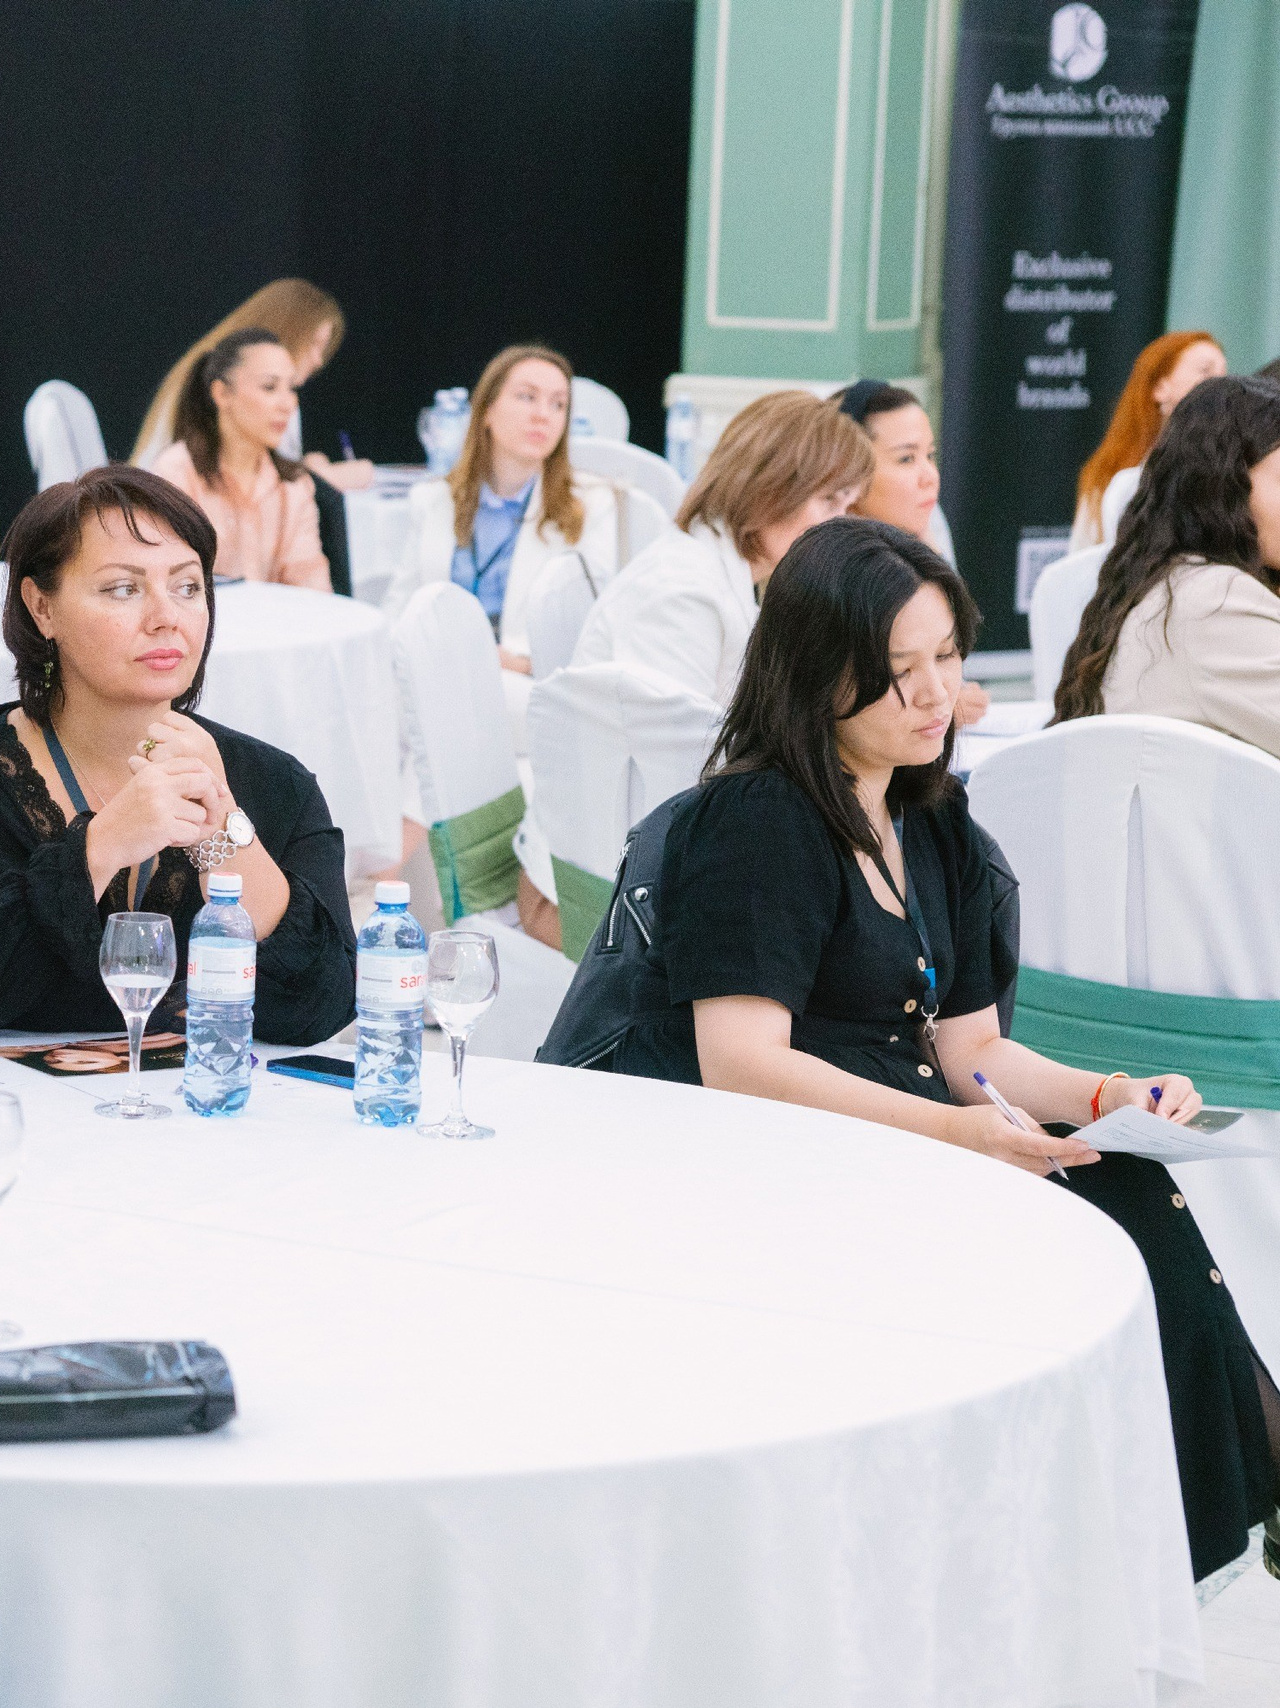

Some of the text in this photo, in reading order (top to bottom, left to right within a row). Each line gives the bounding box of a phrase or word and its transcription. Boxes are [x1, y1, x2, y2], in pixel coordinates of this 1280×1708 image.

[1097, 84, 1169, 124] Group
[1013, 250, 1112, 279] Exclusive
[1004, 283, 1117, 312] distributor
[1046, 315, 1073, 345] of
[1025, 349, 1087, 377] world
[1018, 380, 1091, 409] brands
